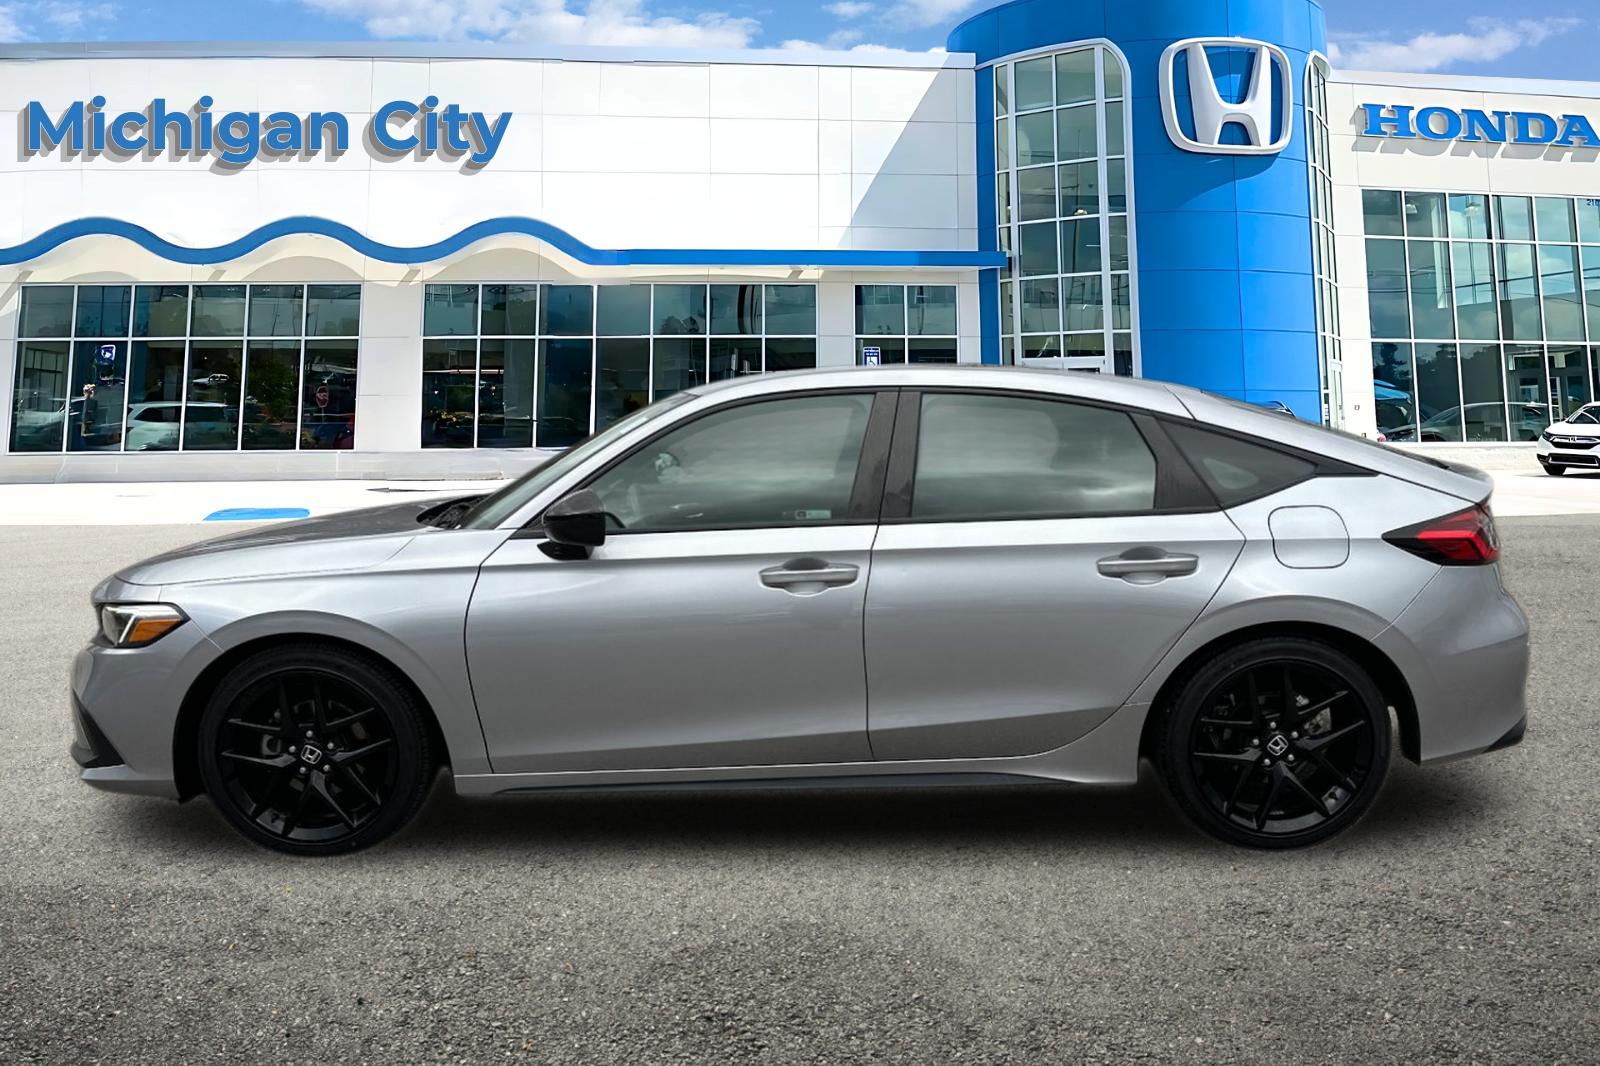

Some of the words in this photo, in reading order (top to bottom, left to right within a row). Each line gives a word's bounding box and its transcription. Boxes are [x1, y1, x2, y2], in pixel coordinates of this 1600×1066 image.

[28, 95, 349, 164] Michigan
[373, 95, 513, 164] City
[1361, 102, 1600, 148] HONDA
